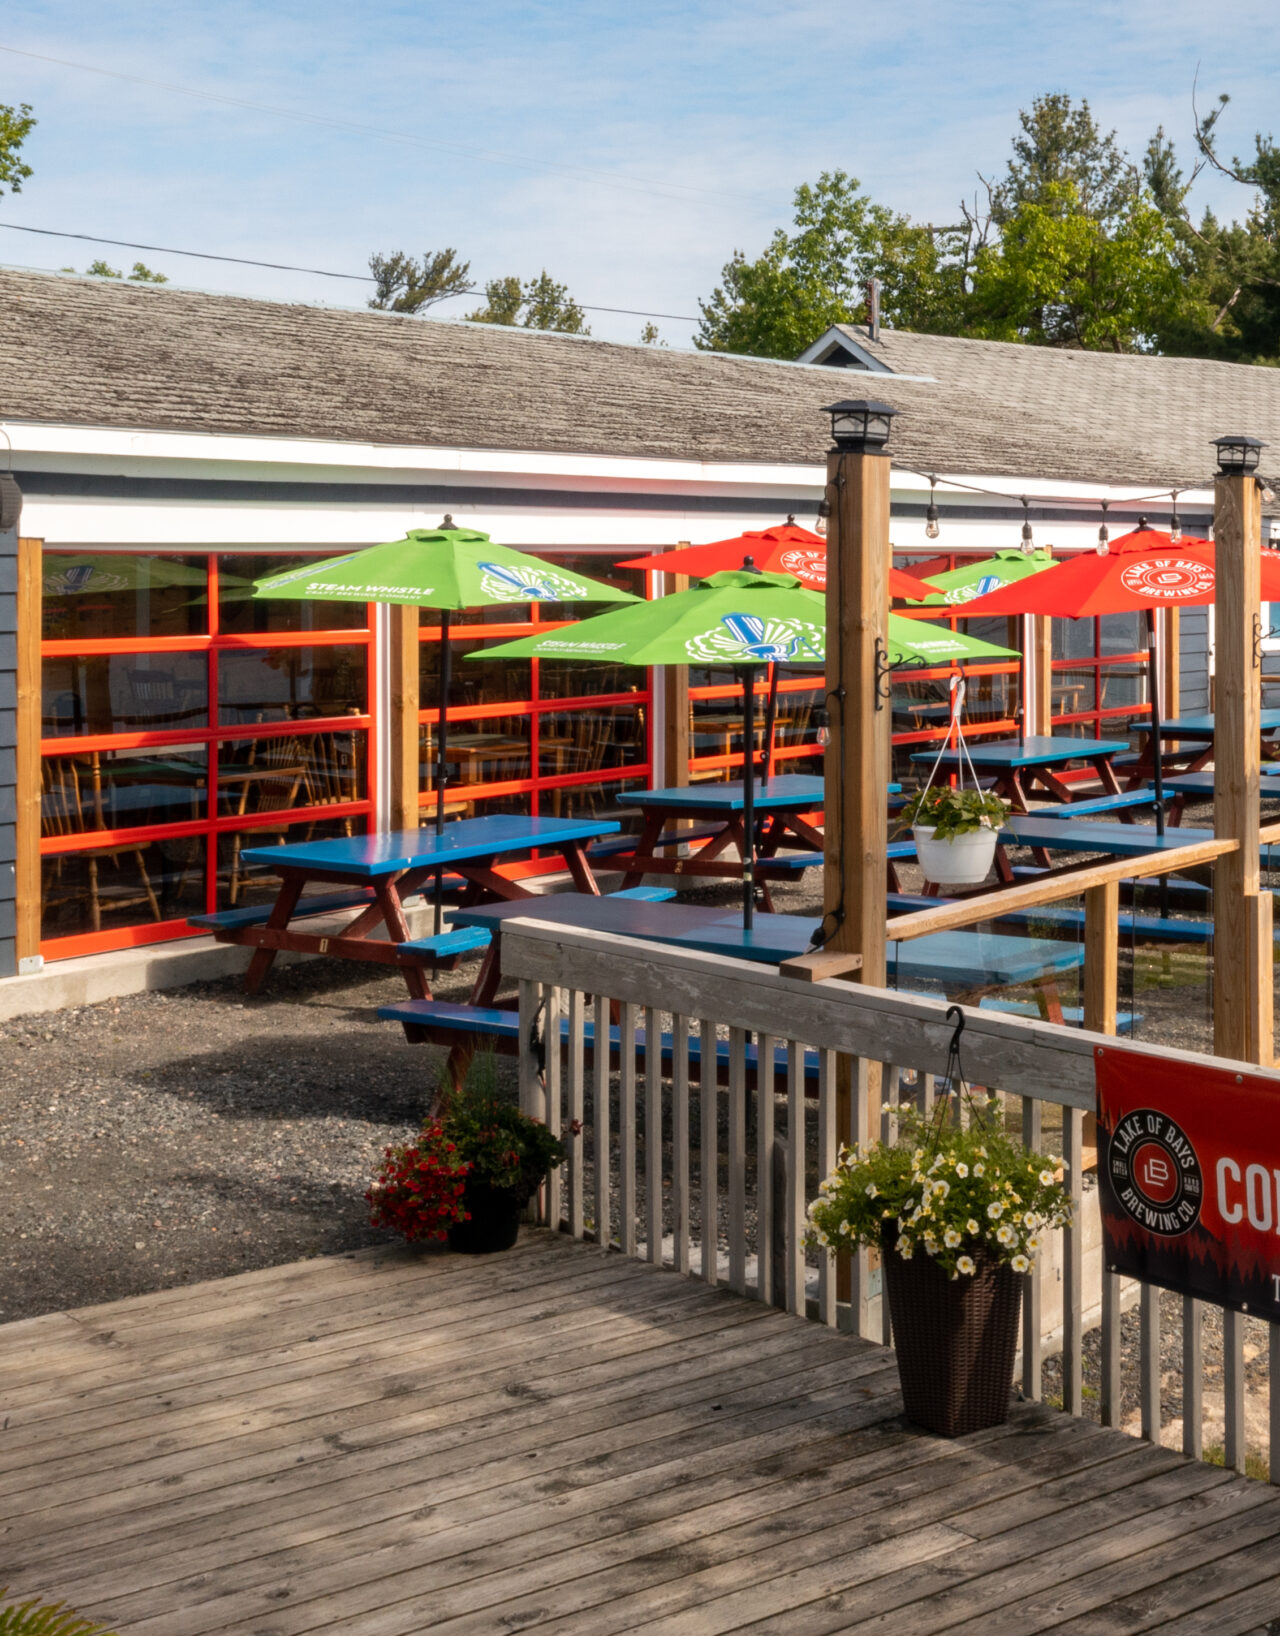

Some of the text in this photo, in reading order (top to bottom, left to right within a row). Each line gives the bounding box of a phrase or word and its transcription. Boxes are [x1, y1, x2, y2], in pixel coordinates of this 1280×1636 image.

[797, 570, 826, 582] BREW
[1125, 563, 1153, 578] LAKE
[1155, 560, 1171, 568] OF
[1175, 560, 1207, 574] BAYS
[305, 582, 435, 596] STEAM WHISTLE
[1138, 586, 1199, 597] BREWING
[1113, 1115, 1195, 1169] LAKE OF BAYS
[1121, 1188, 1196, 1231] BREWING CO.
